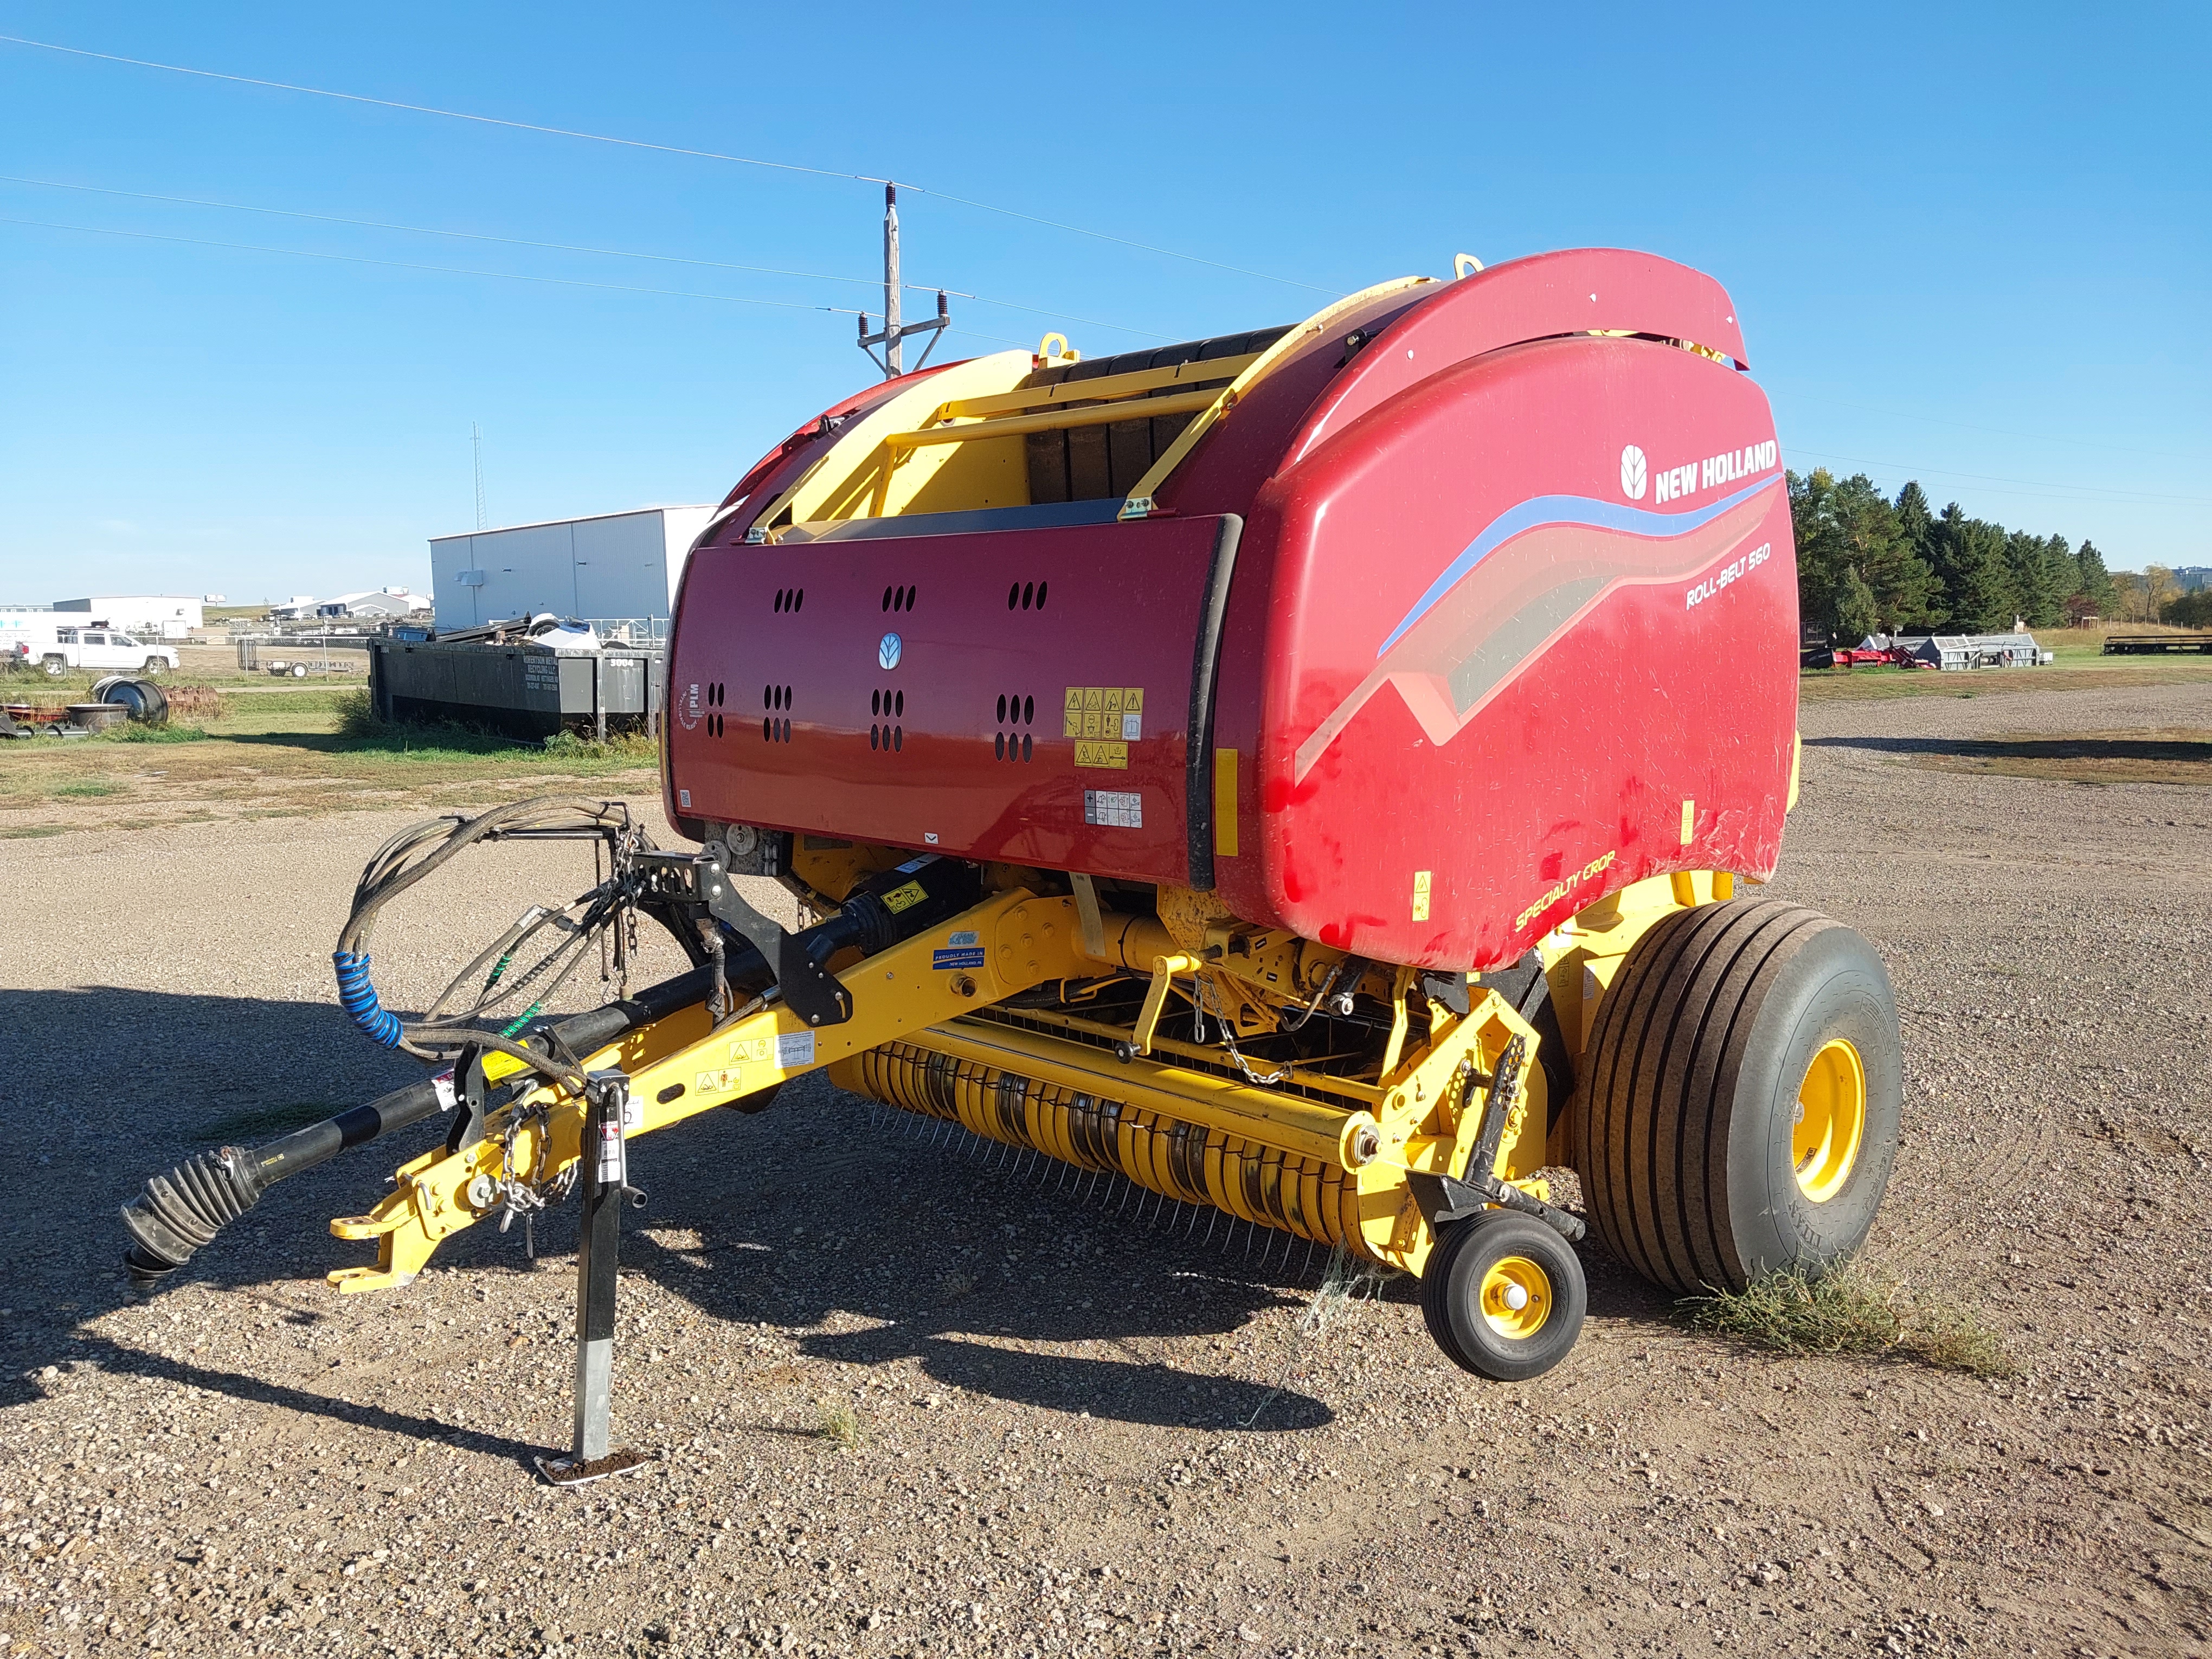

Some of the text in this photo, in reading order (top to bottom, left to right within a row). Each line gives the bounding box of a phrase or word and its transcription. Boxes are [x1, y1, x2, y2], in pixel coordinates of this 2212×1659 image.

[1655, 440, 1777, 505] NEW HOLLAND
[1686, 542, 1771, 611] ROLL-BELT 560
[545, 656, 558, 666] METAL
[610, 659, 634, 667] 3004
[690, 684, 699, 708] PLM
[686, 719, 697, 730] READY
[1515, 850, 1616, 933] SPECIALTY CROP
